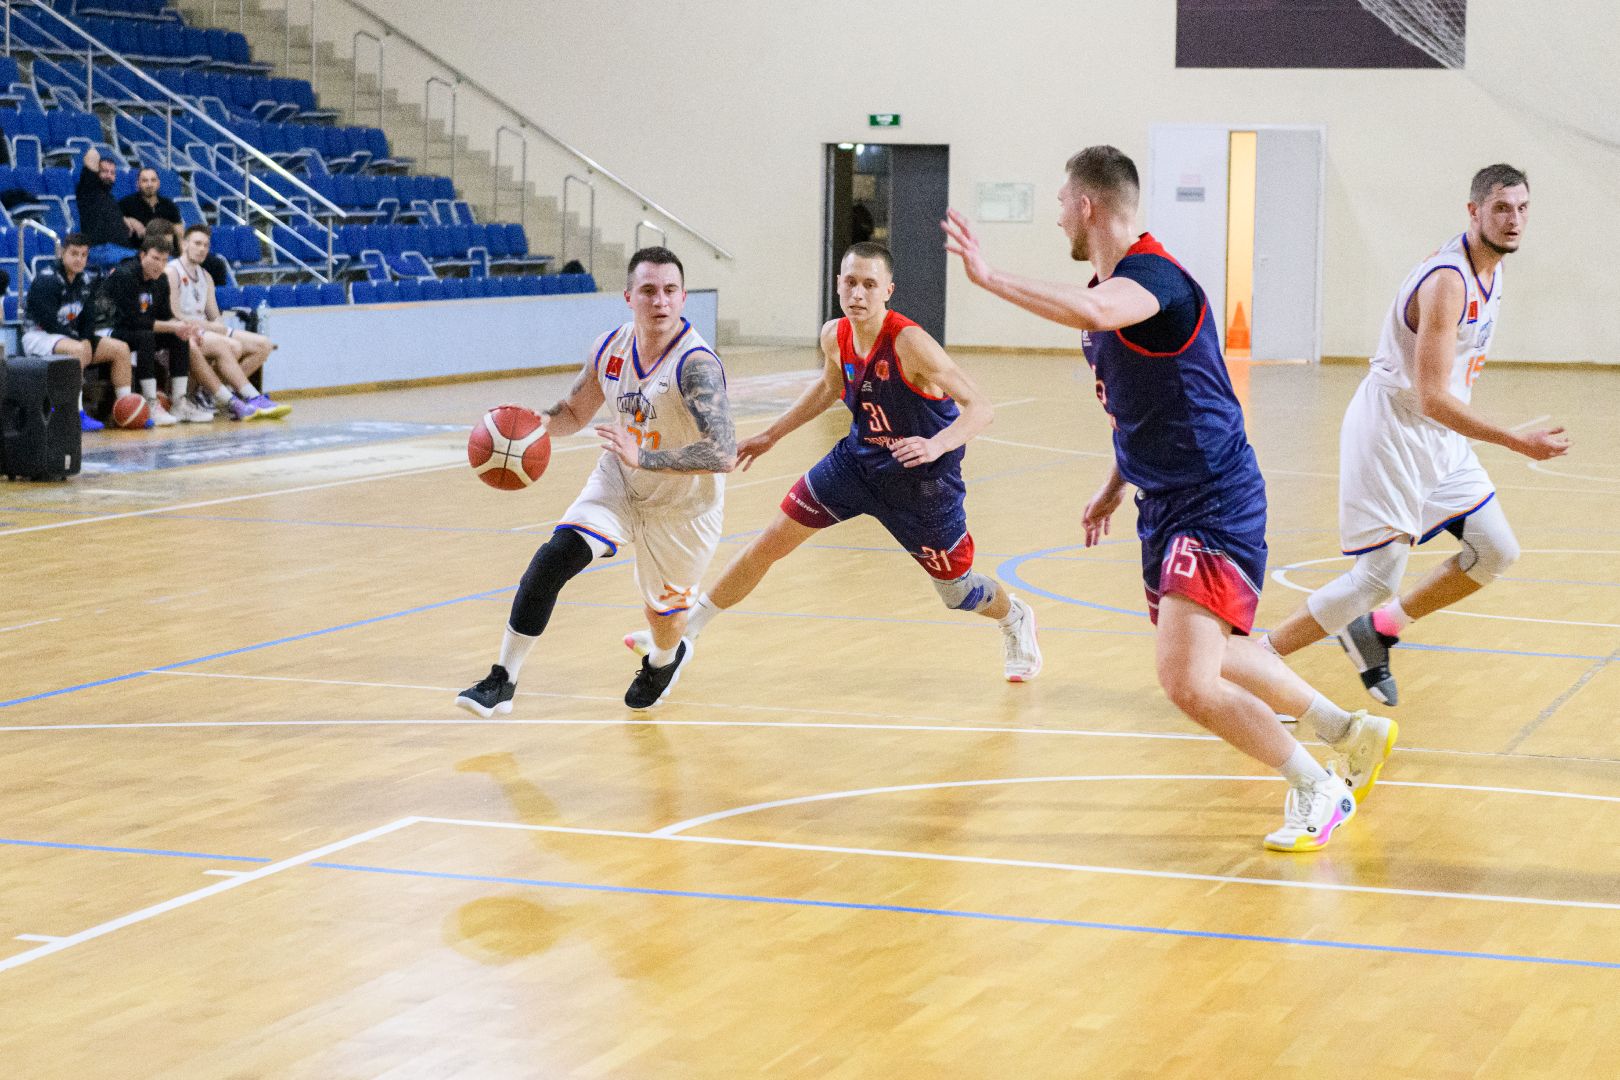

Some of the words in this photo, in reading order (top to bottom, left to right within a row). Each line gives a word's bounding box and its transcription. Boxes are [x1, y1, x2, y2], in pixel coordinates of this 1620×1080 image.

[862, 402, 892, 432] 31
[921, 546, 952, 571] 31
[1166, 536, 1201, 578] 15
